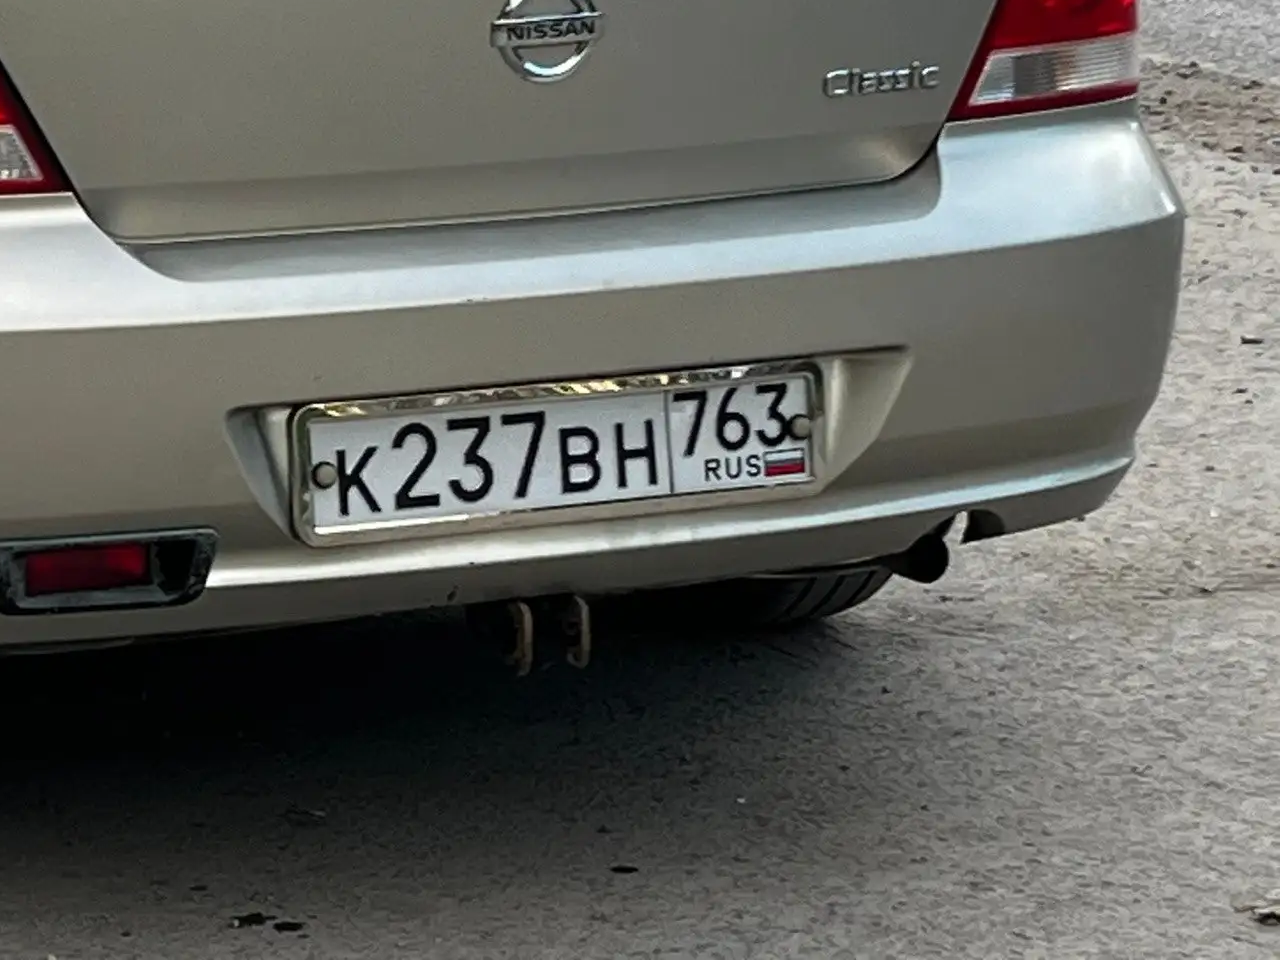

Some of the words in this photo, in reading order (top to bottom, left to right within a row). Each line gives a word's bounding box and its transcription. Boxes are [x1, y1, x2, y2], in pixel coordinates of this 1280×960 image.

[506, 19, 597, 42] NISSAN
[822, 60, 941, 98] Classic
[336, 410, 659, 517] К237ВН
[672, 383, 792, 458] 763
[704, 456, 762, 482] RUS
